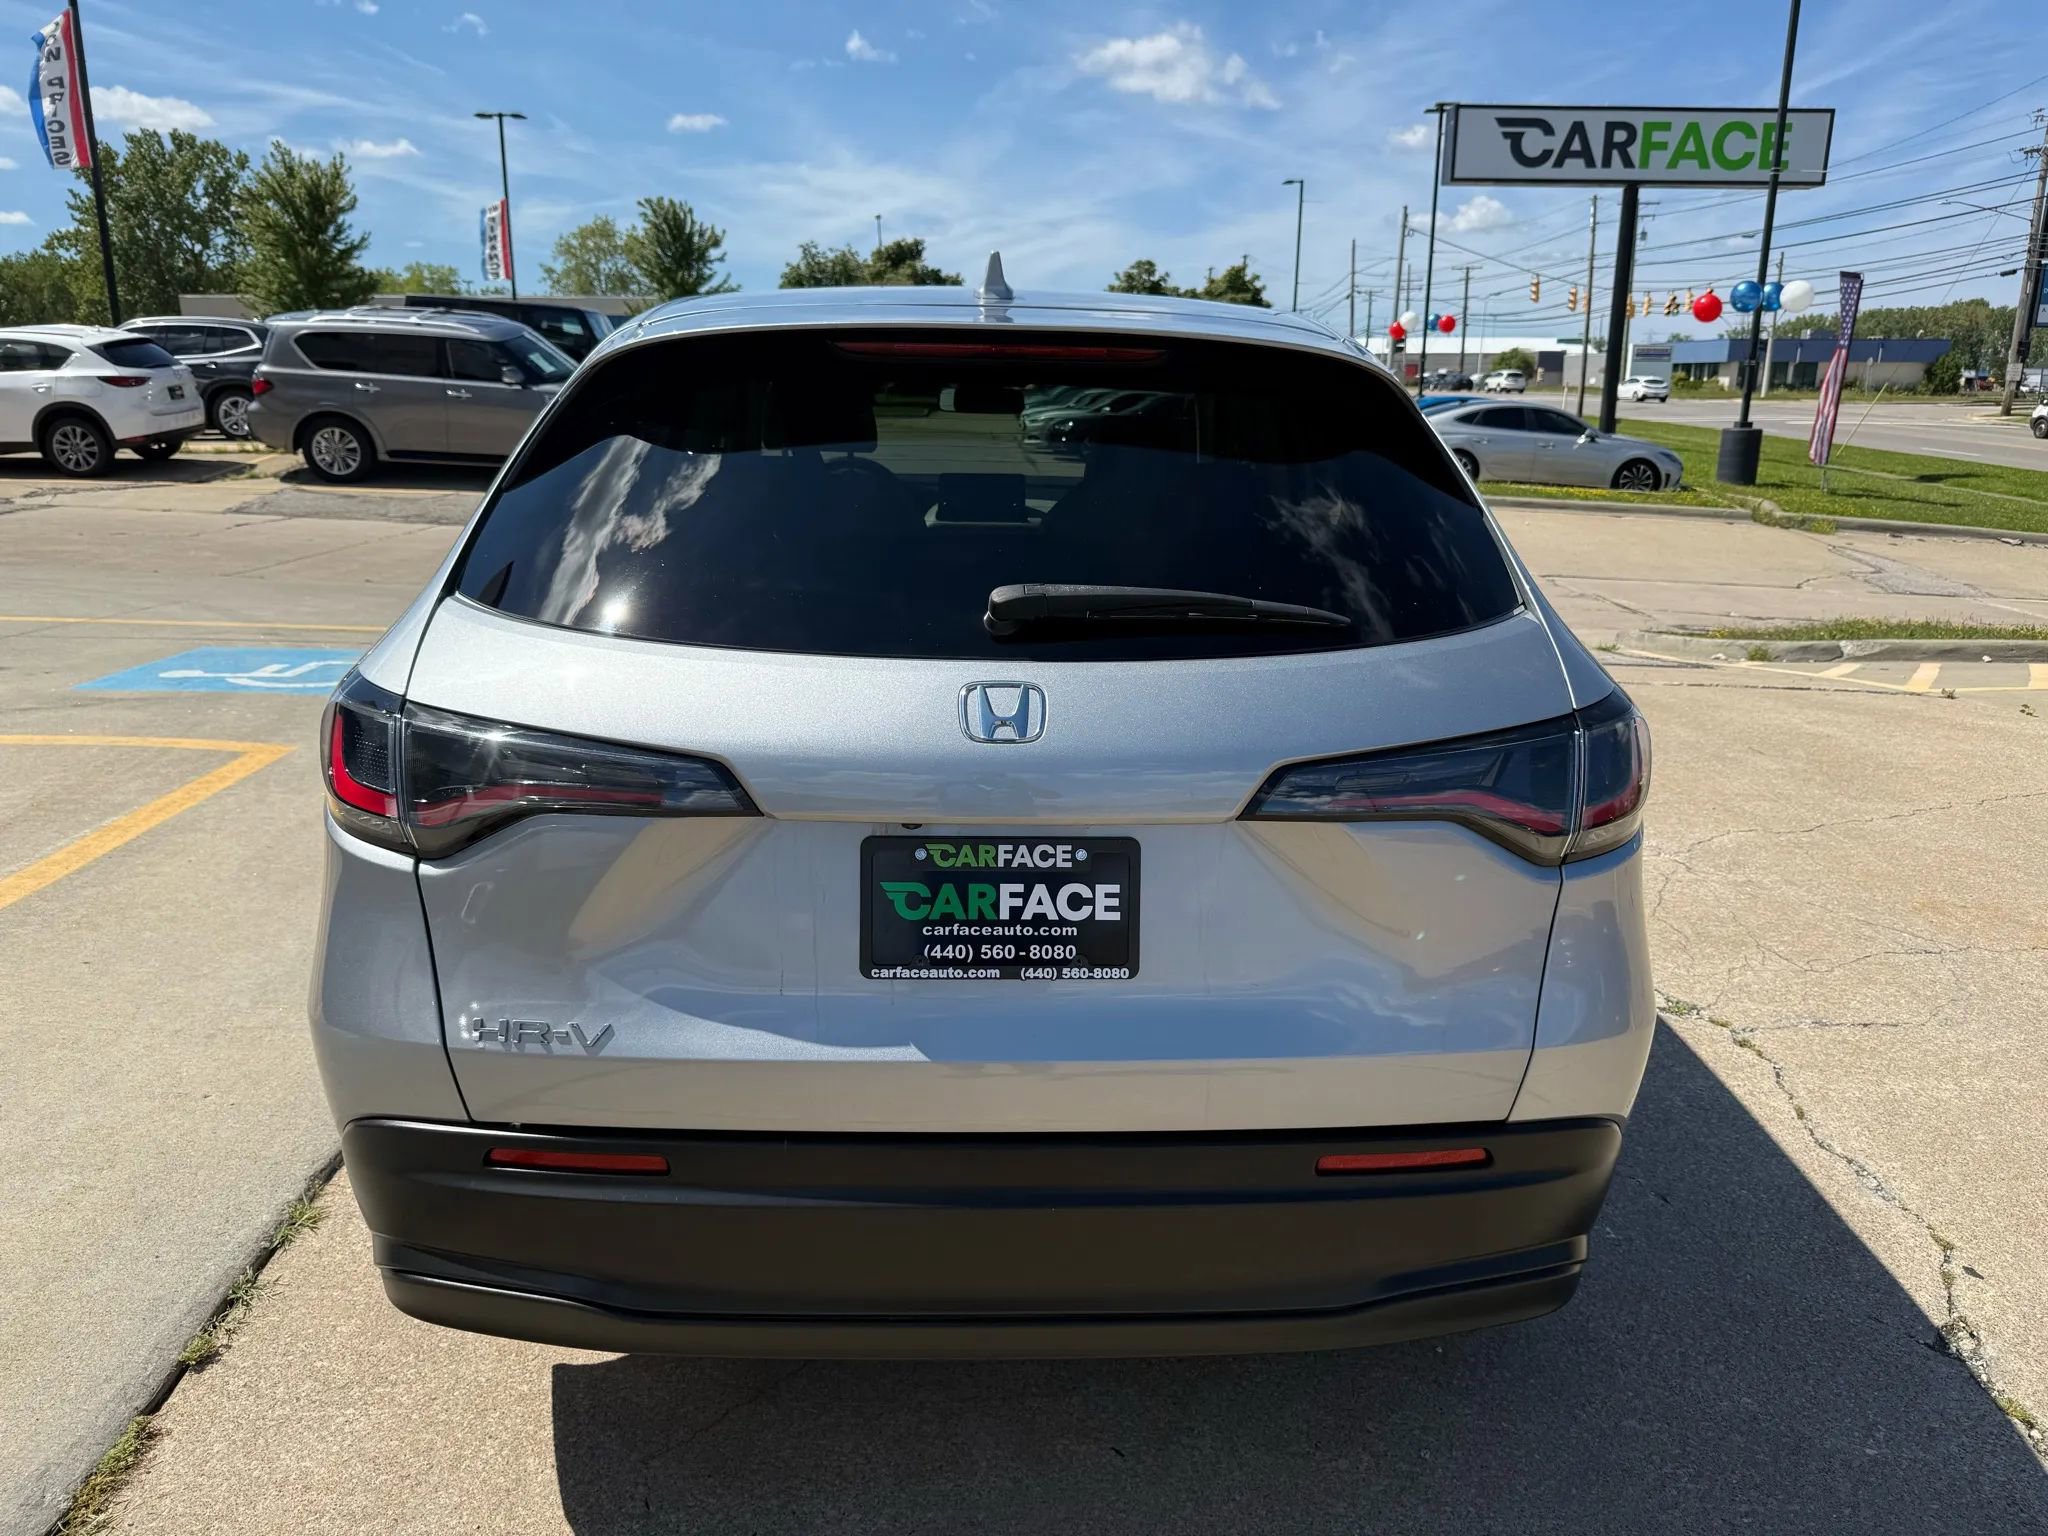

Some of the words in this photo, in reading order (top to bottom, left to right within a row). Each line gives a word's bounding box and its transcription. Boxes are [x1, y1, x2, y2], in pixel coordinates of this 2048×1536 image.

[1495, 116, 1793, 172] CARFACE
[925, 843, 1073, 868] CARFACE
[879, 881, 1121, 921] CARFACE
[922, 923, 1078, 936] carfaceauto.com
[923, 944, 974, 963] (440)
[871, 966, 1000, 979] carfaceauto.com
[1020, 967, 1057, 980] (440)
[1061, 967, 1130, 979] 560-8080
[471, 1017, 615, 1049] HR-V
